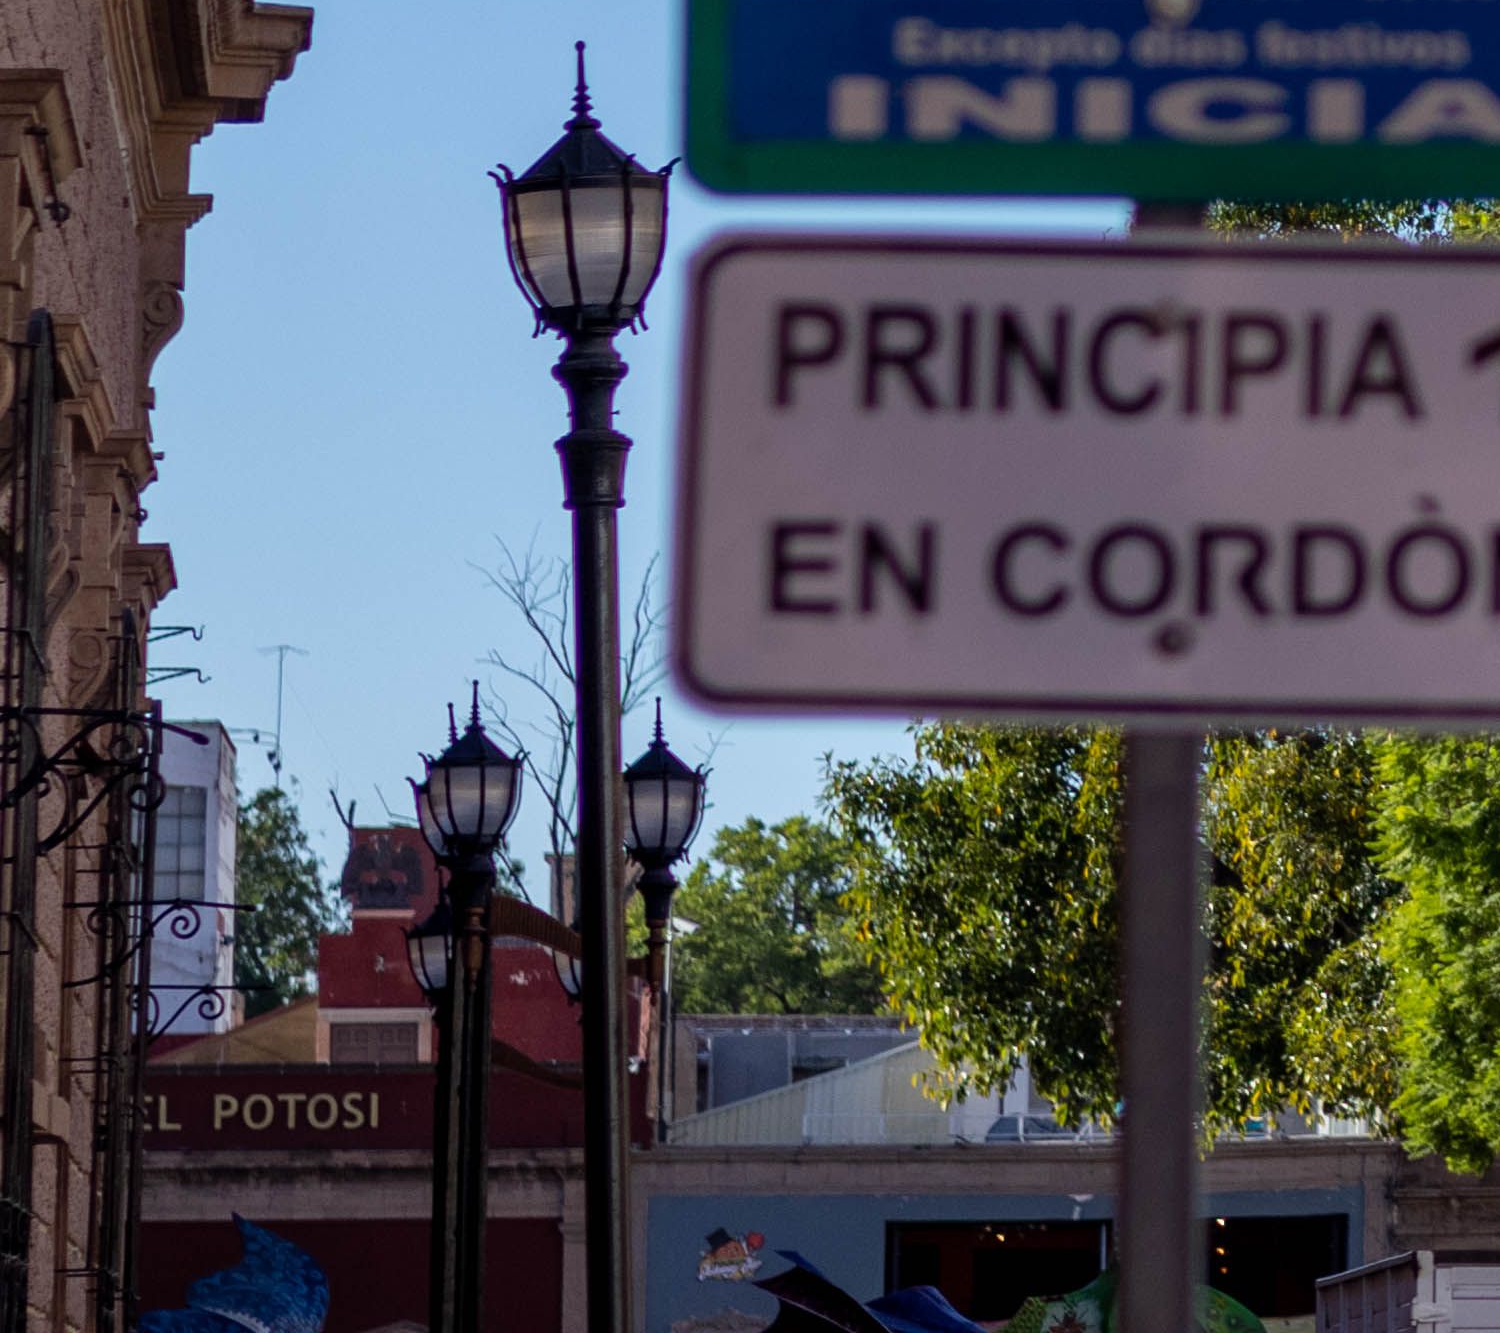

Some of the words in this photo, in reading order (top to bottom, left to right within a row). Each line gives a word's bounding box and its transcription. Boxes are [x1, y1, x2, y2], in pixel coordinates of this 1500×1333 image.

[892, 16, 1121, 69] Excepto
[1257, 20, 1471, 68] festivos
[770, 300, 1422, 420] PRINCIPIA
[766, 519, 938, 617] EN
[214, 1091, 379, 1131] POTOSI
